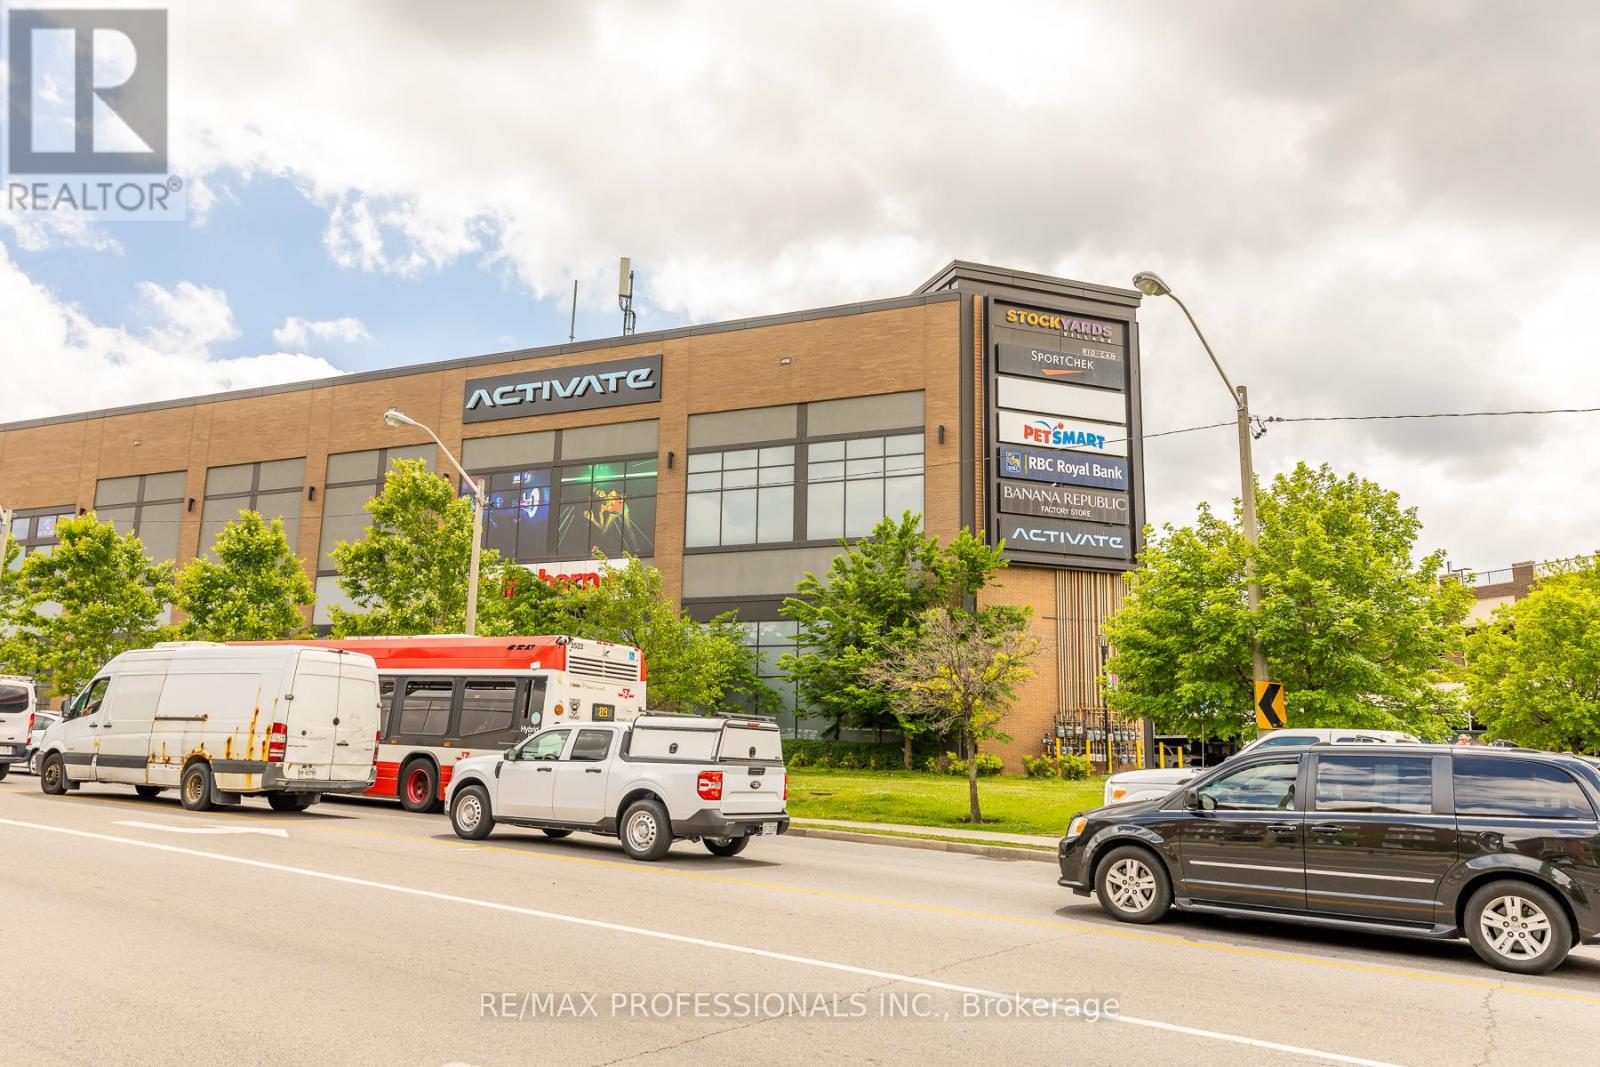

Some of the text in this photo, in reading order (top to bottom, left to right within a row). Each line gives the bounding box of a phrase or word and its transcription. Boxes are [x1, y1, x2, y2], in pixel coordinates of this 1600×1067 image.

[1006, 309, 1113, 338] STOCKYARDS
[466, 367, 656, 410] ACTIVATE
[1028, 456, 1054, 472] RBC
[1057, 459, 1090, 478] Royal
[1093, 464, 1123, 480] Bank
[1004, 486, 1127, 511] BANANA REPUBLIC
[1040, 505, 1091, 518] FACTORY STORE
[1012, 527, 1125, 549] ACTIVATE
